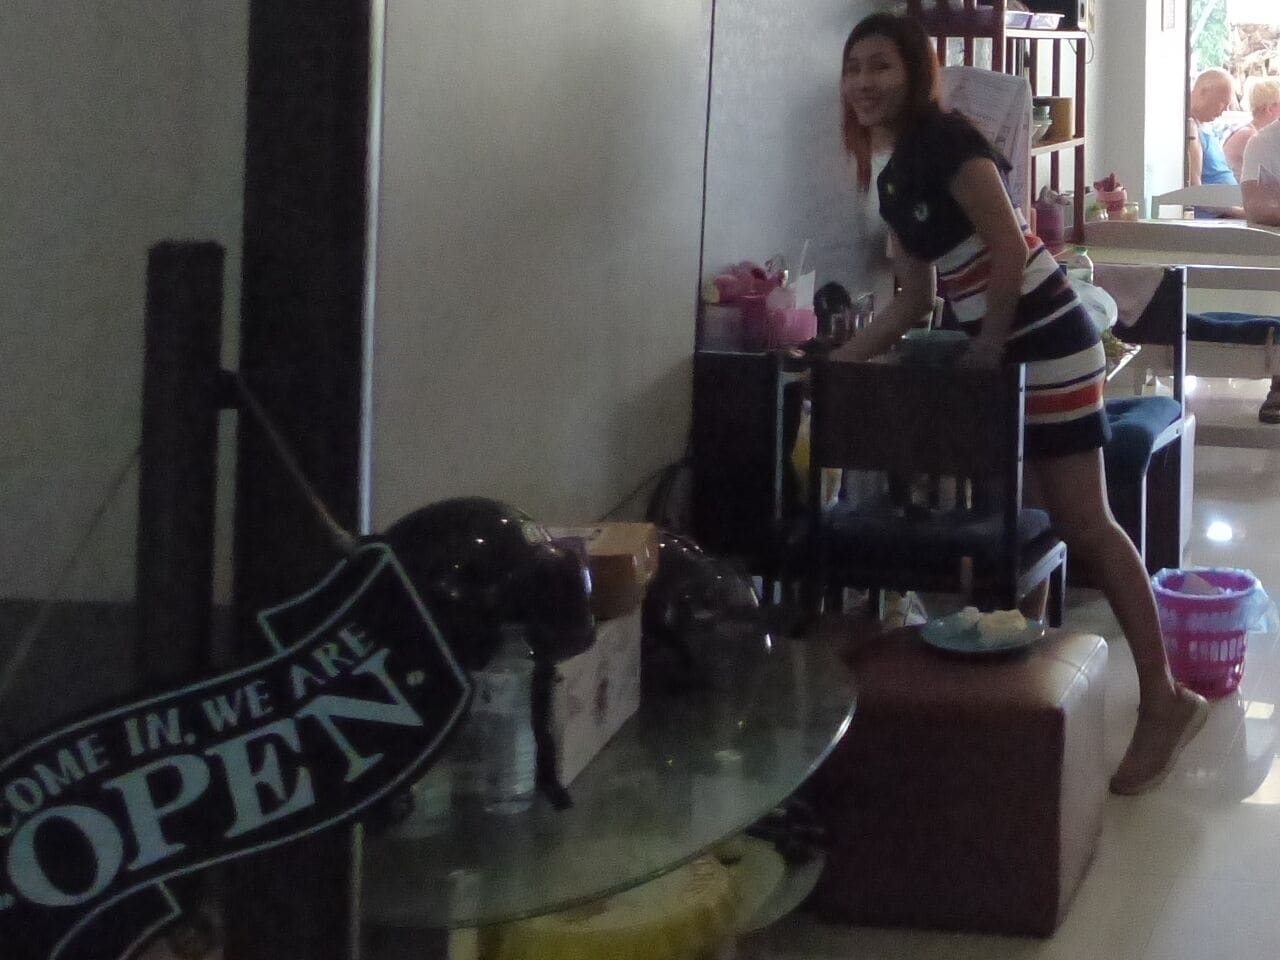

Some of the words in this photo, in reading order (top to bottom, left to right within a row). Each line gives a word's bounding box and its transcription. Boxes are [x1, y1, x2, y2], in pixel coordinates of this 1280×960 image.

[203, 680, 273, 733] WE
[289, 621, 377, 698] ARE
[7, 648, 424, 908] OPEN
